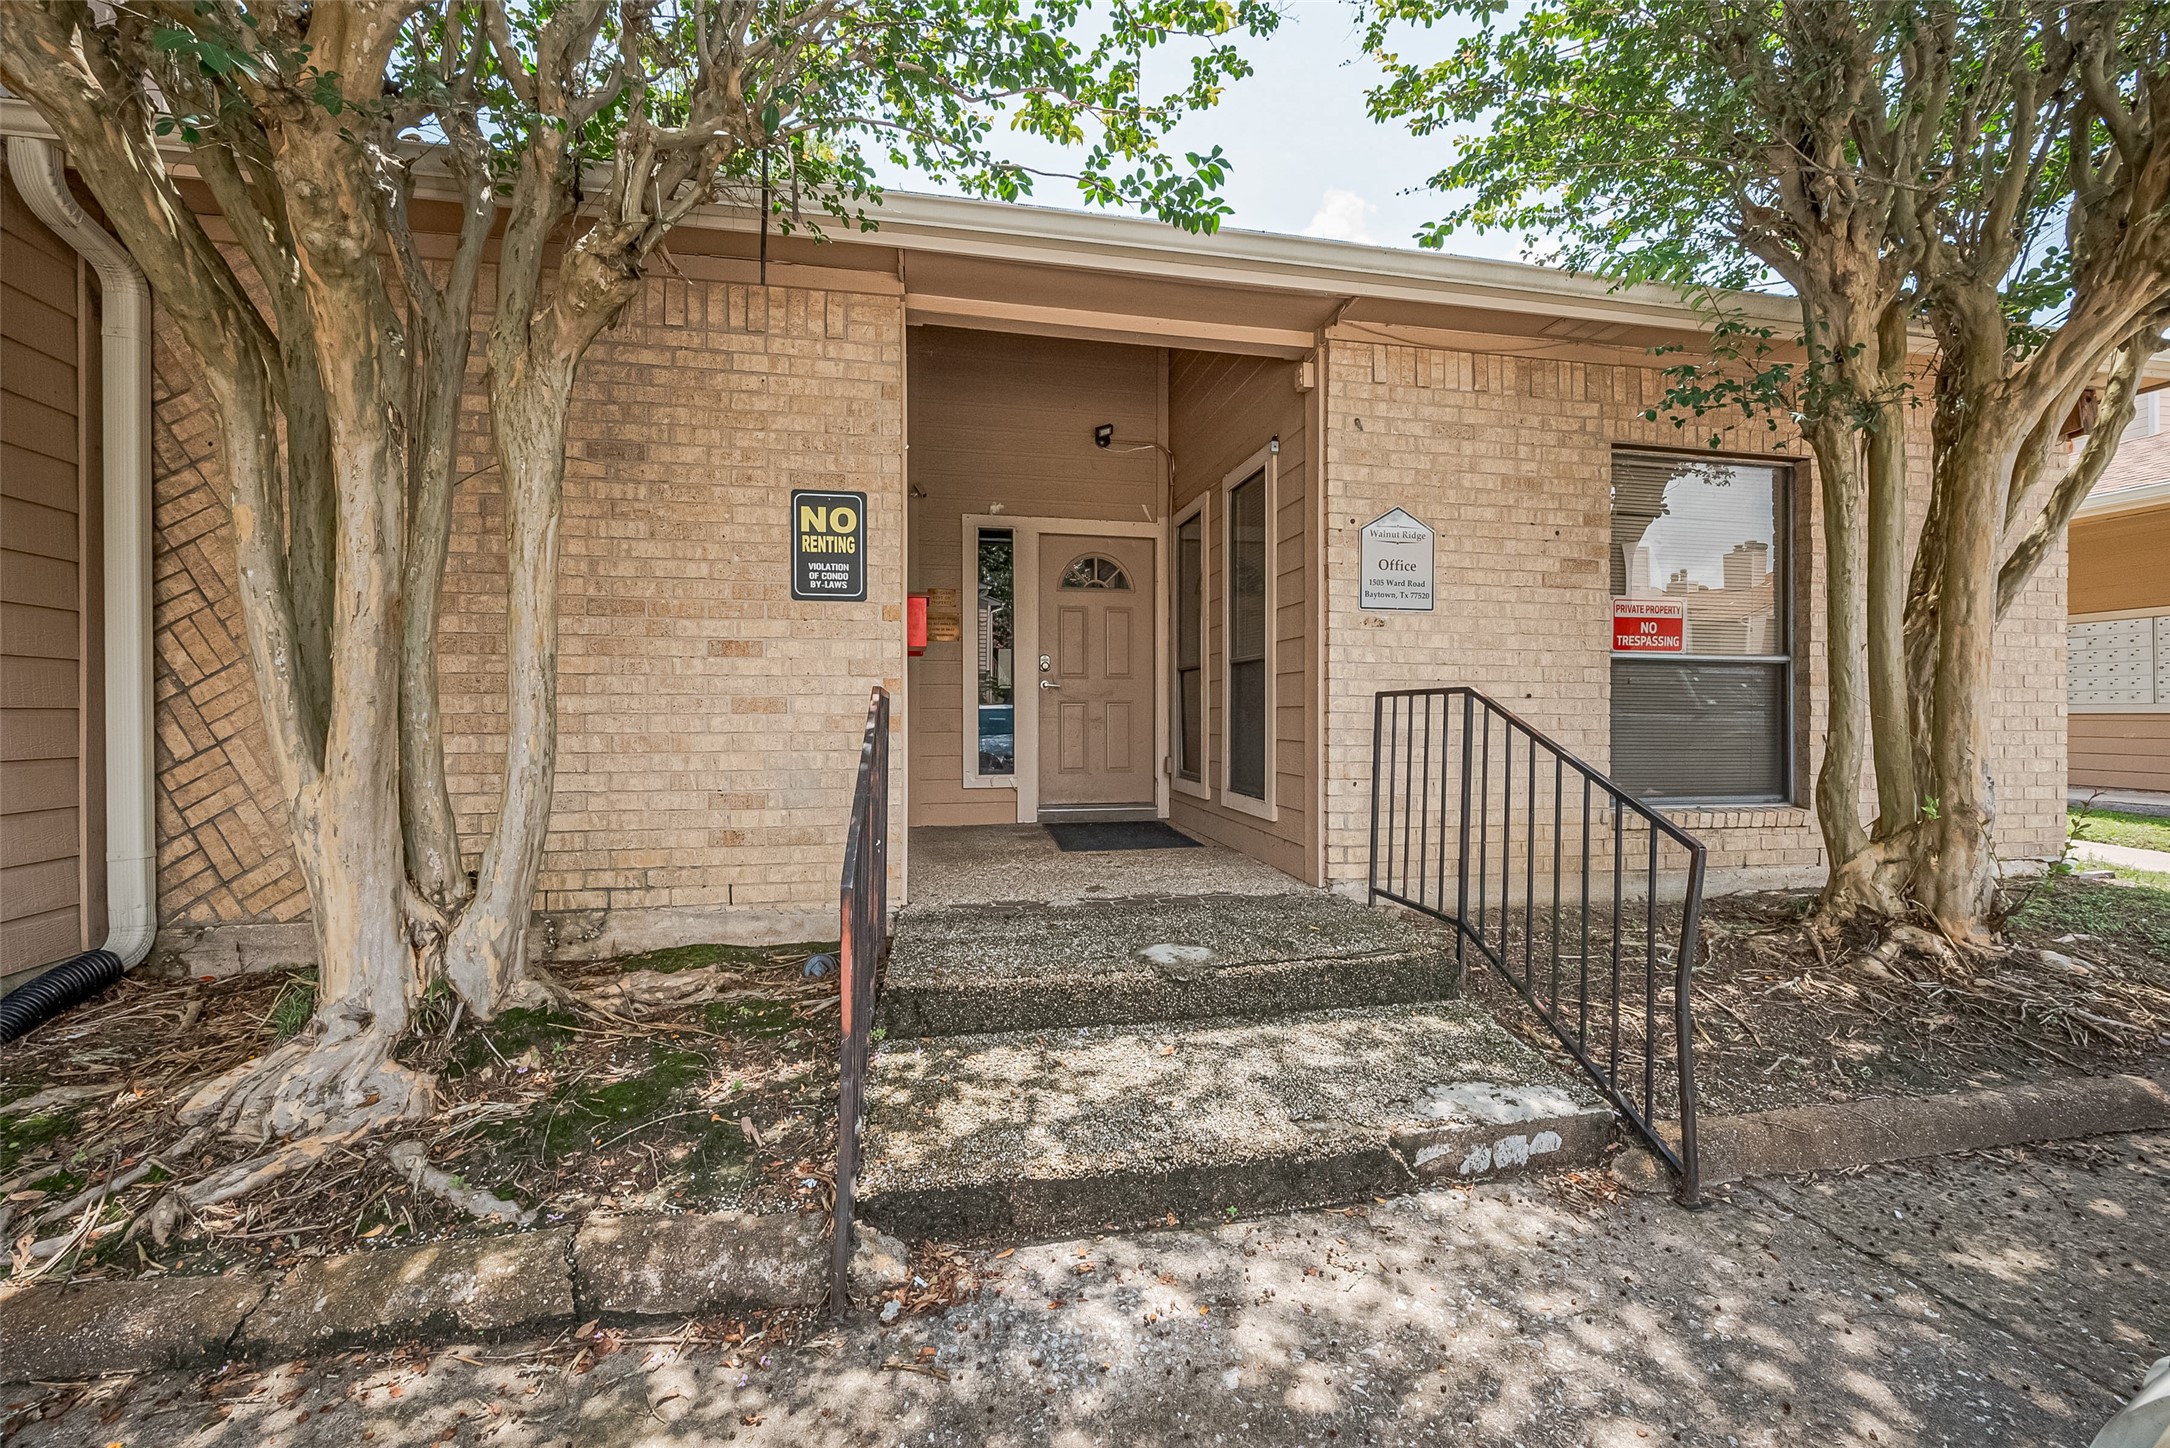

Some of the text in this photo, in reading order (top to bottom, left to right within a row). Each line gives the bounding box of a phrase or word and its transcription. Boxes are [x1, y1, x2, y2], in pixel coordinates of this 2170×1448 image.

[801, 505, 857, 533] NO
[1369, 529, 1426, 541] Walnut Ridge
[802, 535, 855, 553] RENTING
[808, 563, 849, 571] VIOLATION
[1378, 559, 1417, 571] Office
[809, 572, 848, 580] OF CONDO
[810, 581, 847, 589] BY-LAWS
[1386, 579, 1405, 587] Ward
[1364, 590, 1398, 600] Baytown,
[1616, 604, 1680, 614] PRIVATE PROPERTY
[1640, 622, 1658, 634] NO
[1616, 635, 1680, 647] TRESPASSING
